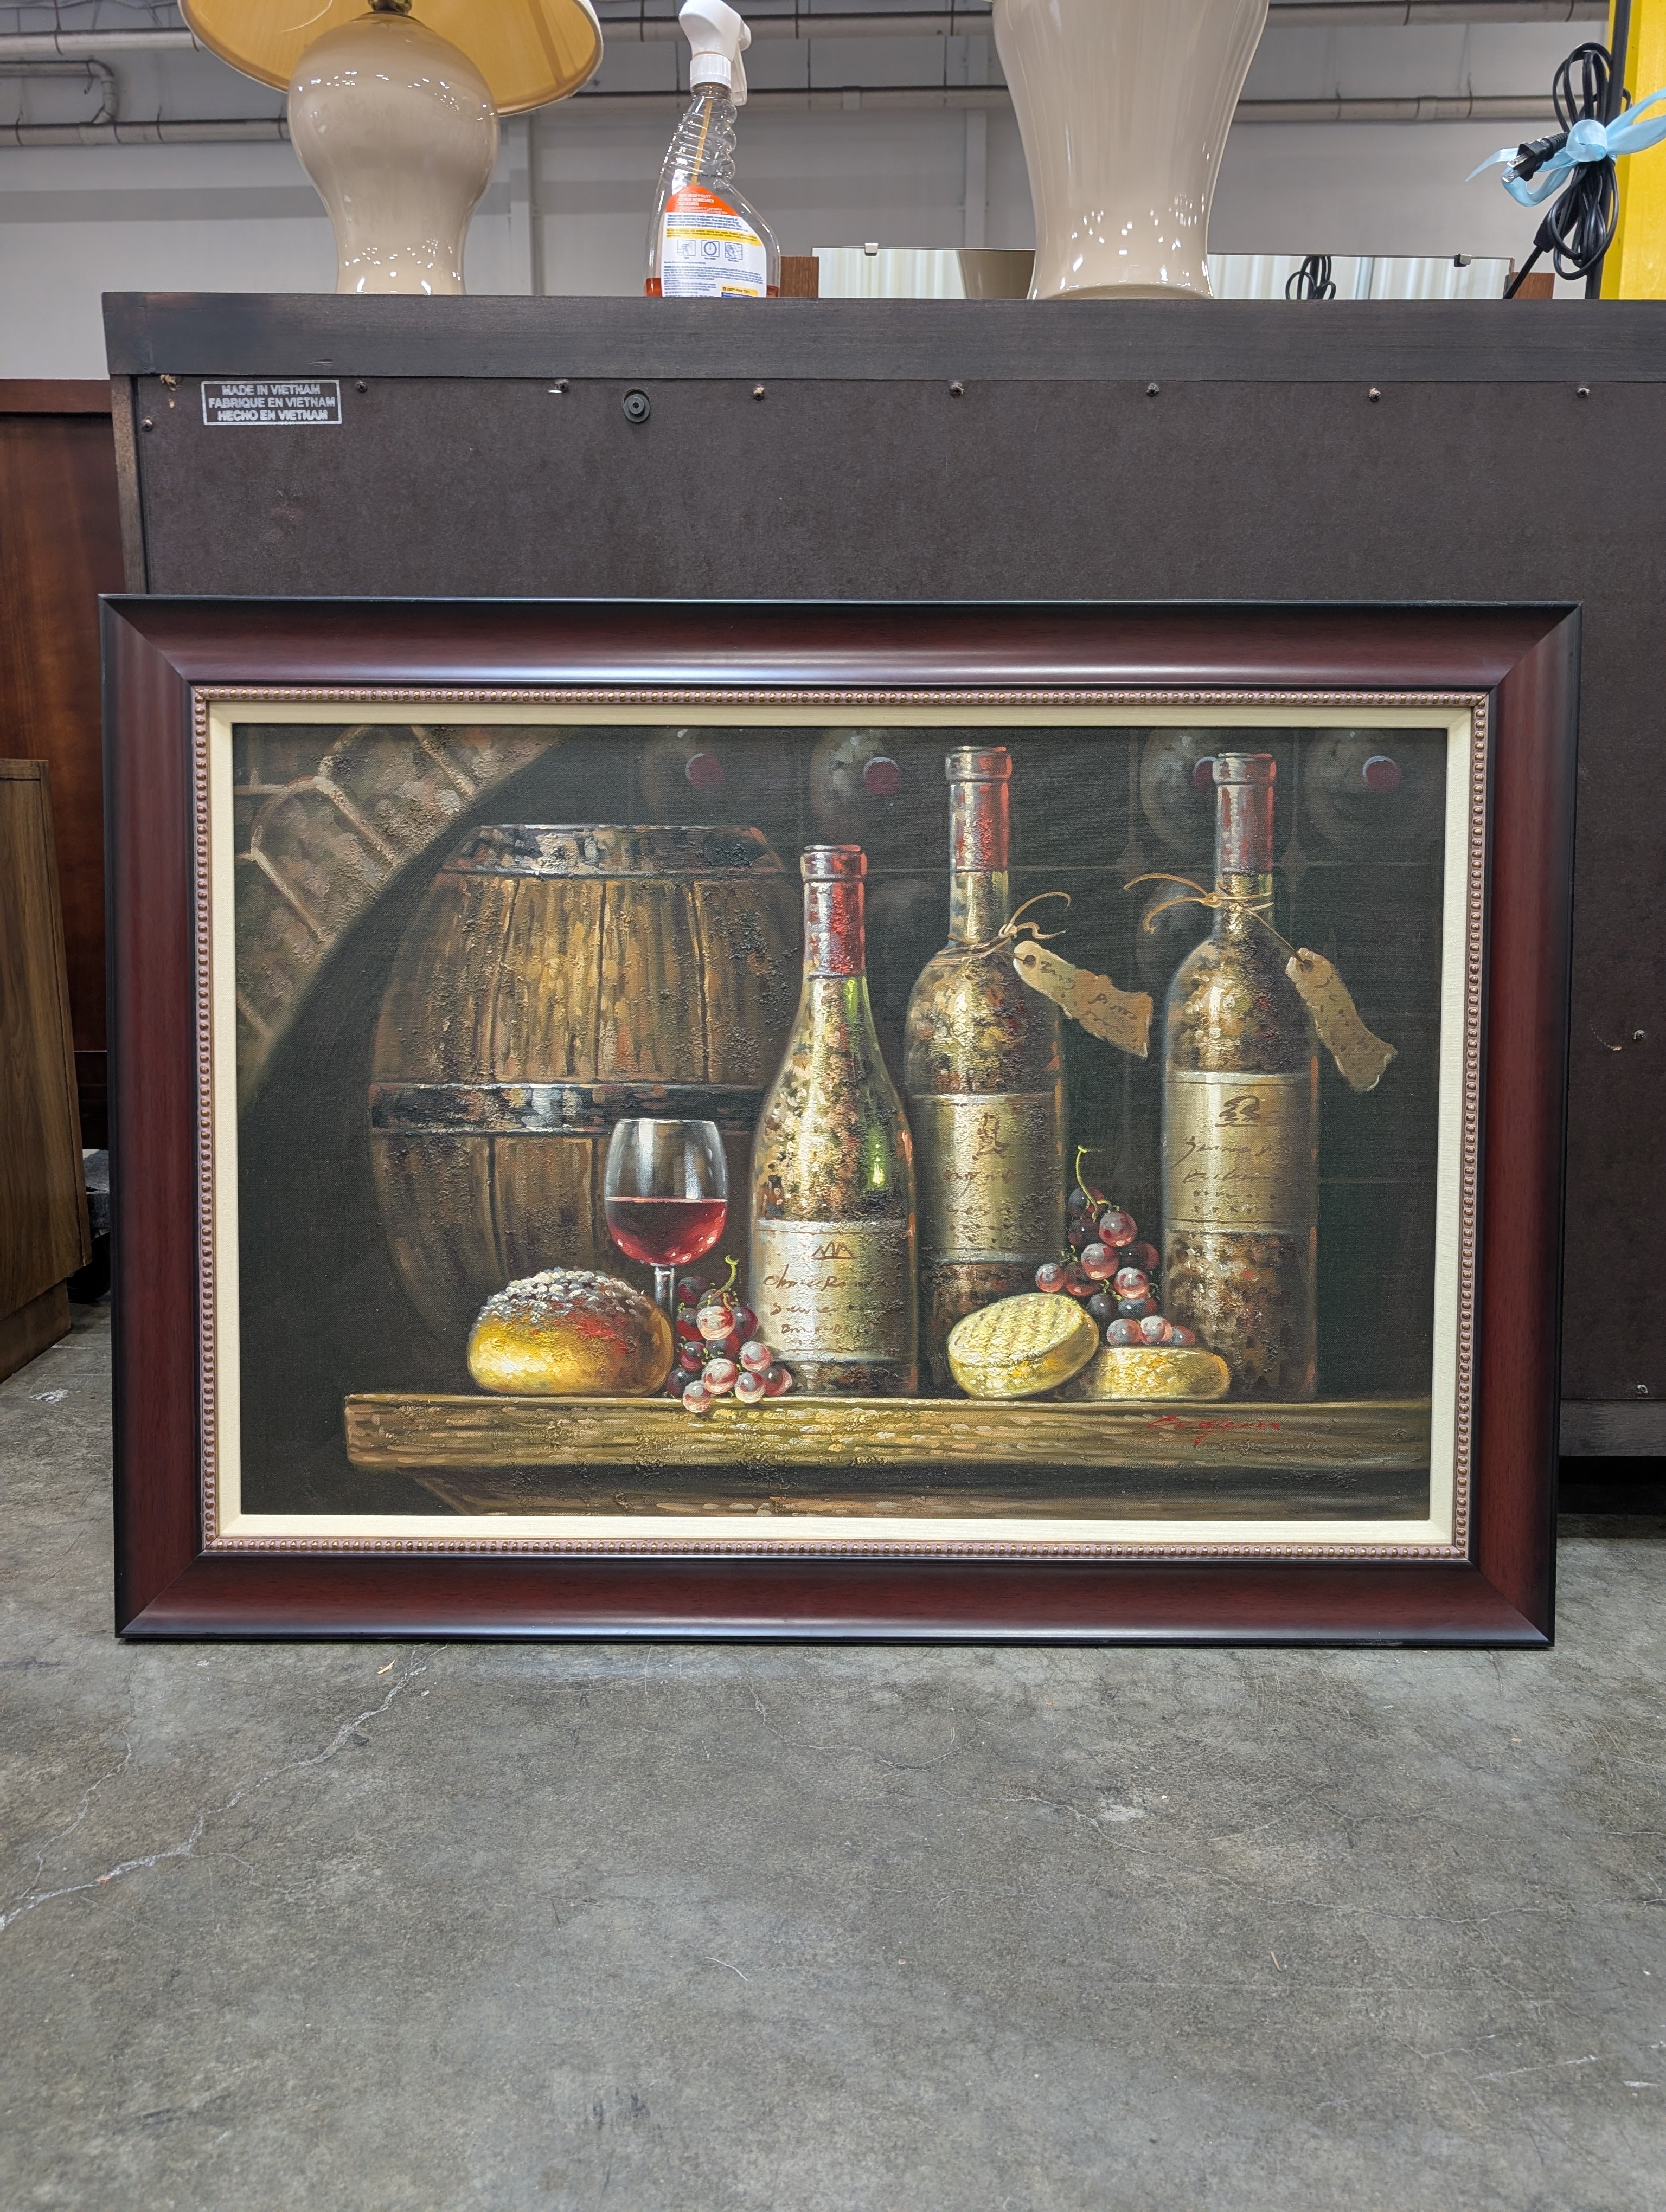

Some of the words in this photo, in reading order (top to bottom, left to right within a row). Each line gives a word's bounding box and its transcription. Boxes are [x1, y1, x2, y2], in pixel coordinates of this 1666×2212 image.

[222, 385, 255, 396] MADE
[257, 385, 268, 395] IN
[270, 384, 321, 395] VIETNAM
[208, 397, 266, 408] FABRIQUE
[267, 397, 284, 408] EN
[285, 397, 336, 407] VIETNAM
[217, 410, 259, 421] HECHO
[260, 410, 276, 420] EN
[278, 409, 328, 420] VIETNAM
